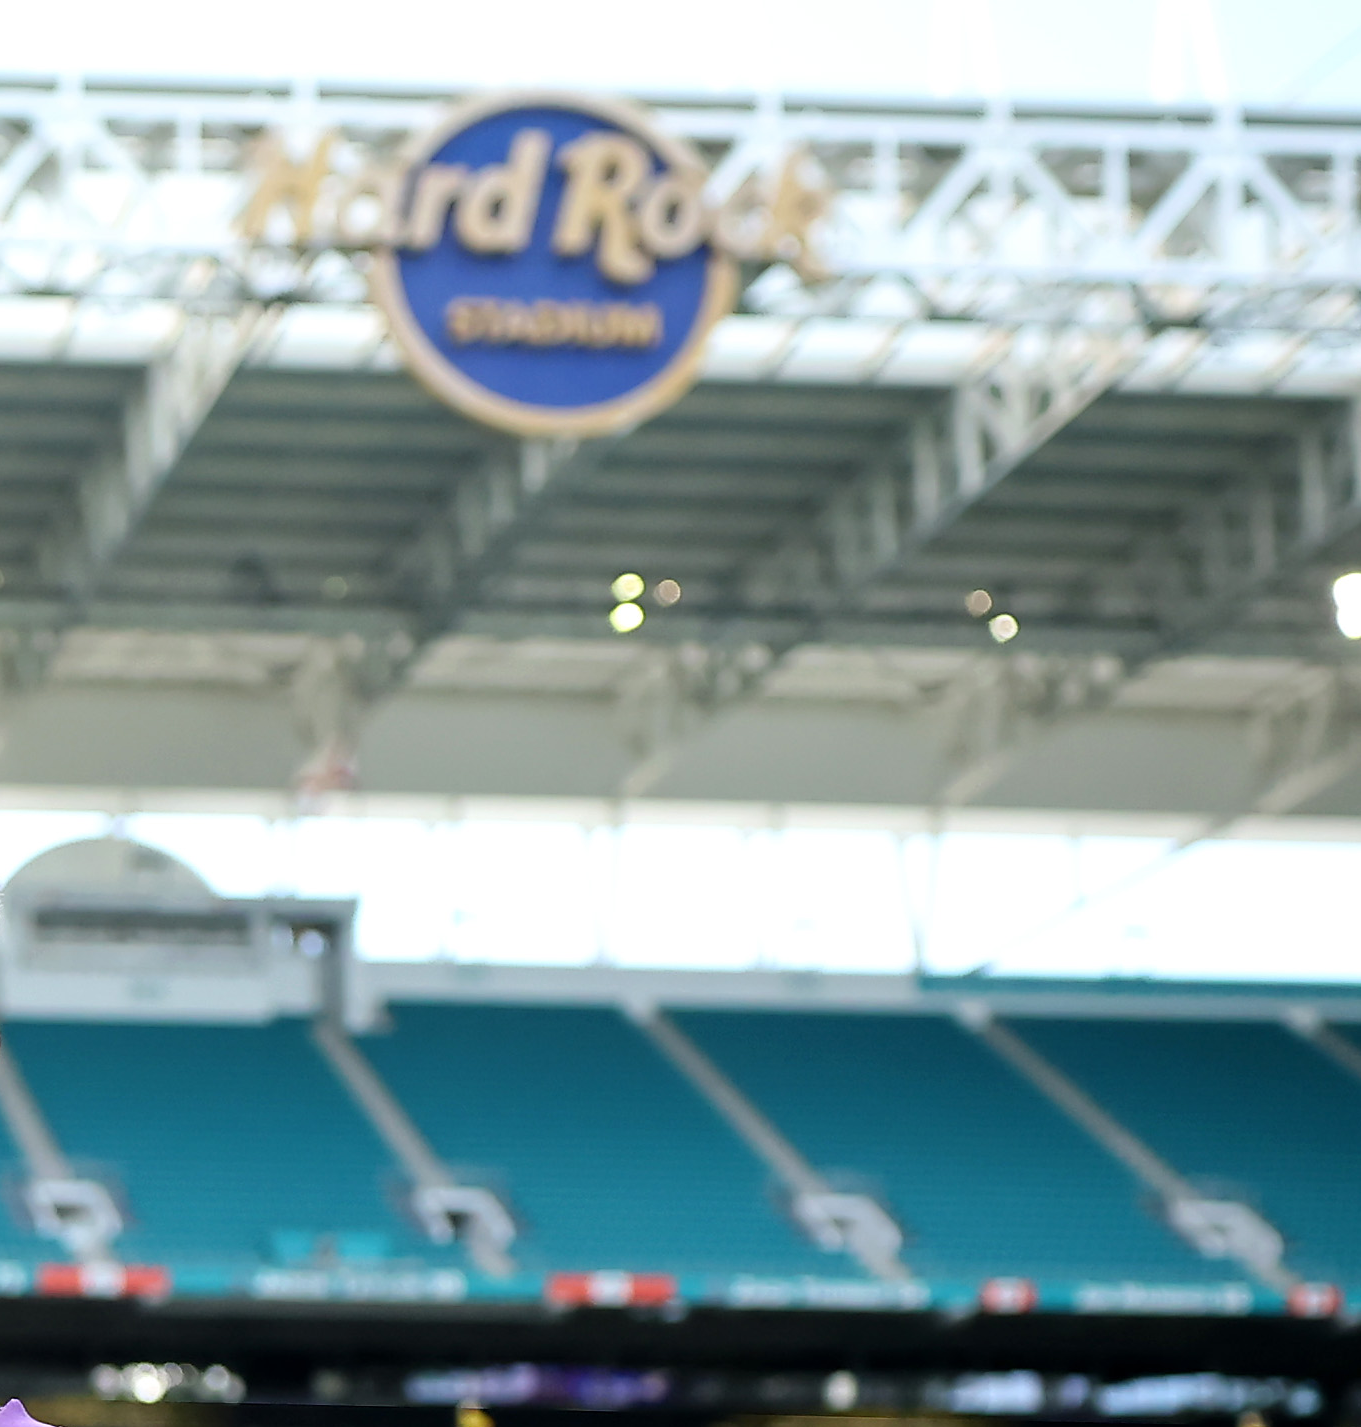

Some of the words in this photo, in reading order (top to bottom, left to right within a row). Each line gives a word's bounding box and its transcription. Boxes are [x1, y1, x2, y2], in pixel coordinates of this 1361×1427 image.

[234, 127, 552, 254] Hard
[549, 131, 833, 285] Rock
[445, 297, 664, 348] STADIUM
